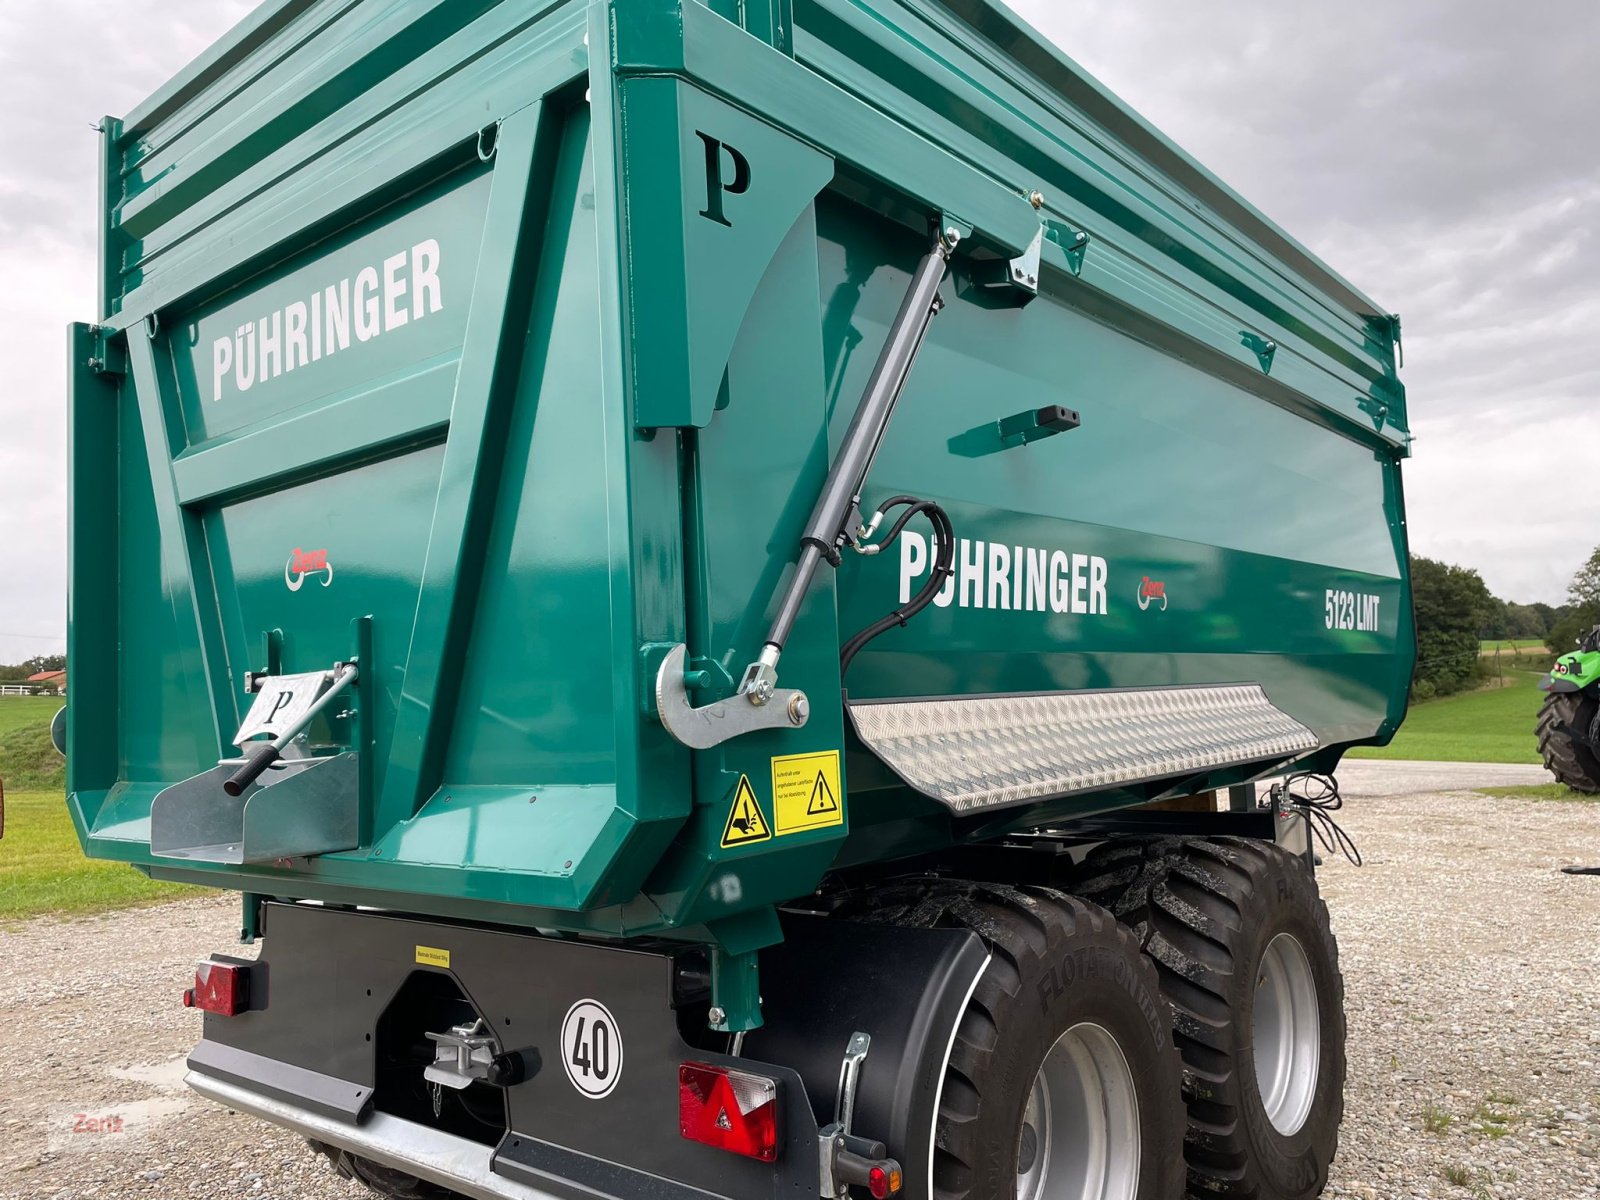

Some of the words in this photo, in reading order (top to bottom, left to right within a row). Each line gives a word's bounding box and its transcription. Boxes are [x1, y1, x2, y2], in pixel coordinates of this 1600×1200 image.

[695, 129, 751, 227] P
[213, 238, 443, 402] PÜHRINGER
[1325, 589, 1355, 630] 5123
[1356, 593, 1380, 631] LMT
[263, 691, 294, 724] P
[572, 1016, 609, 1080] 40
